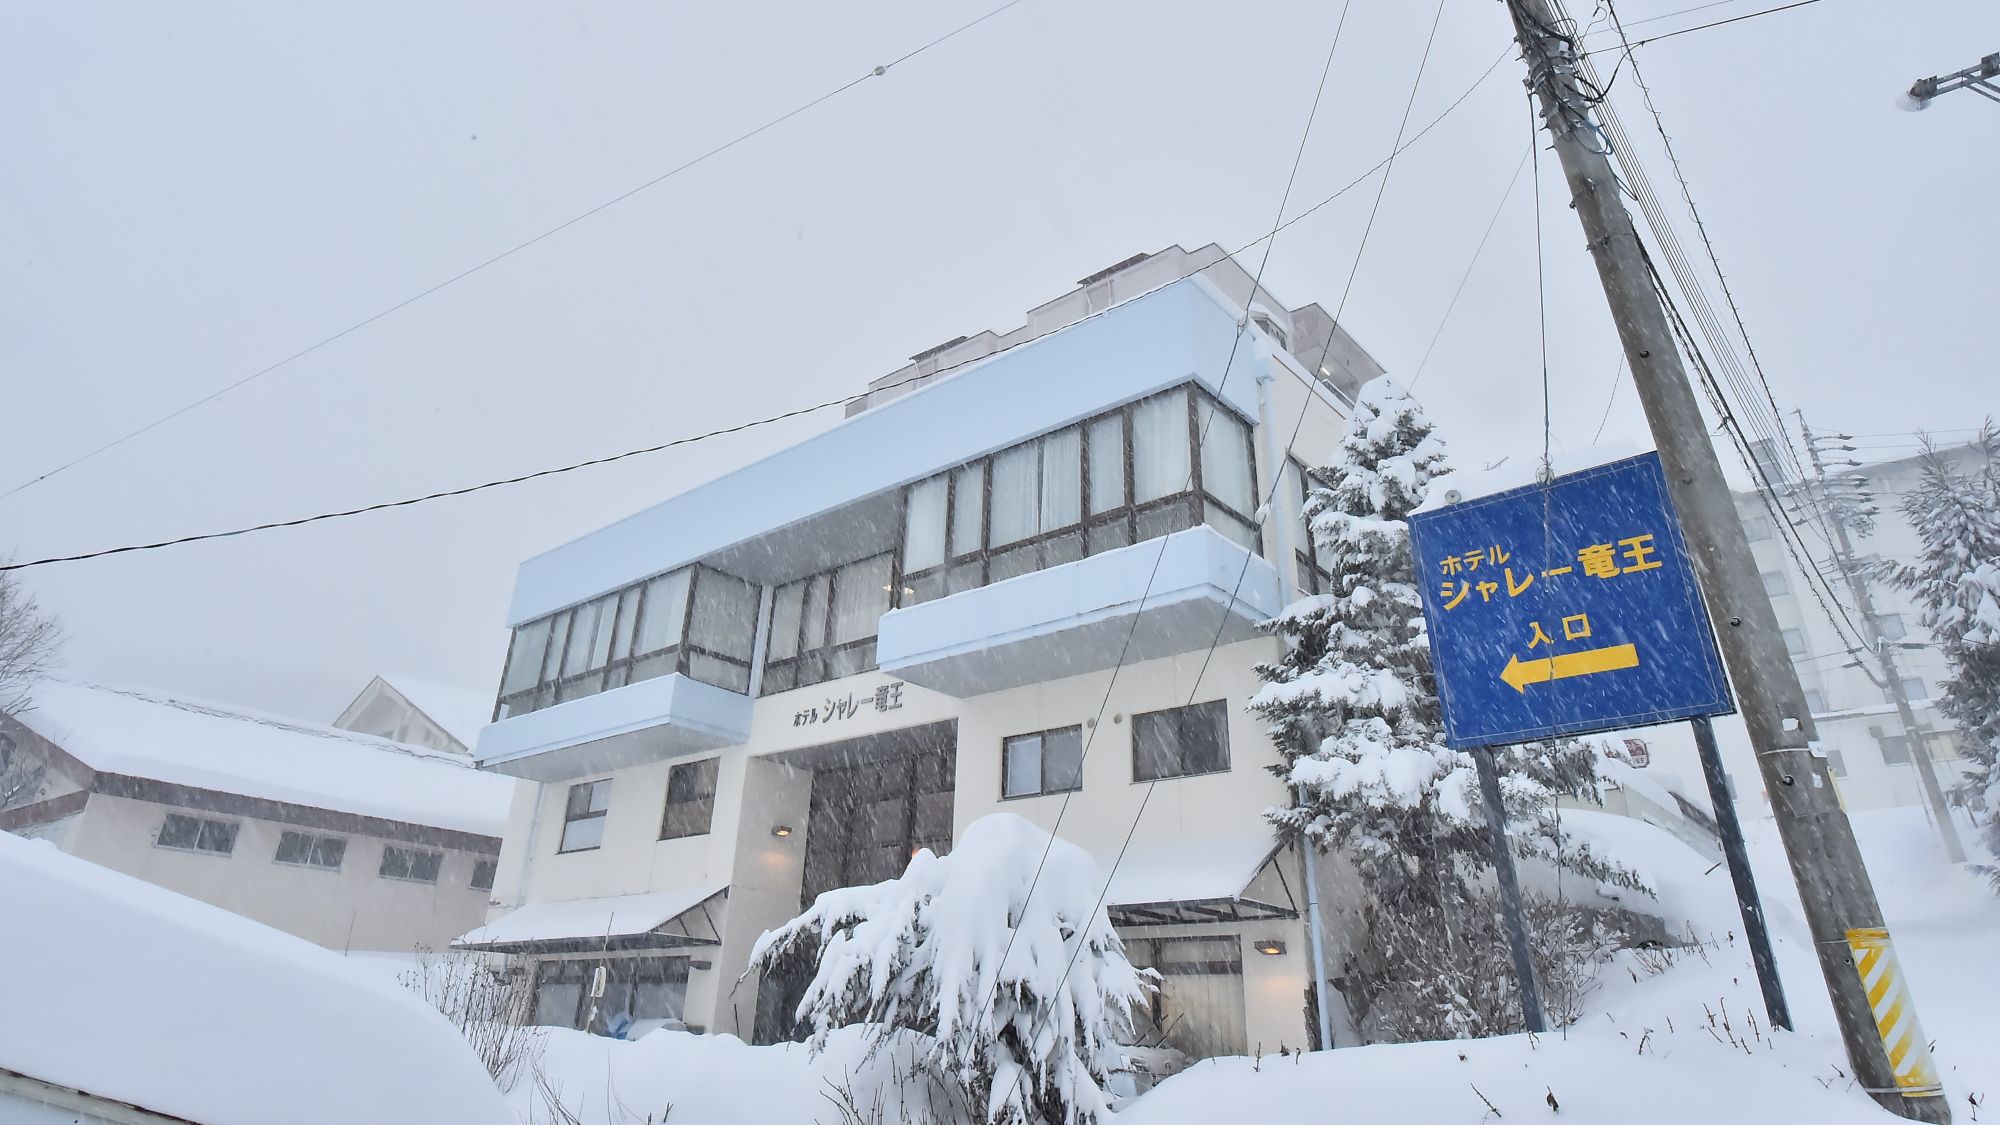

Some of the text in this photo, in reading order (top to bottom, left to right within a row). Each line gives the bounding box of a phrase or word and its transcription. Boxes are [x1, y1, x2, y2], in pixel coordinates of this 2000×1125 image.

[1440, 544, 1511, 576] ホテル
[1440, 534, 1663, 611] シャレー竜王
[1528, 613, 1592, 649] 入口
